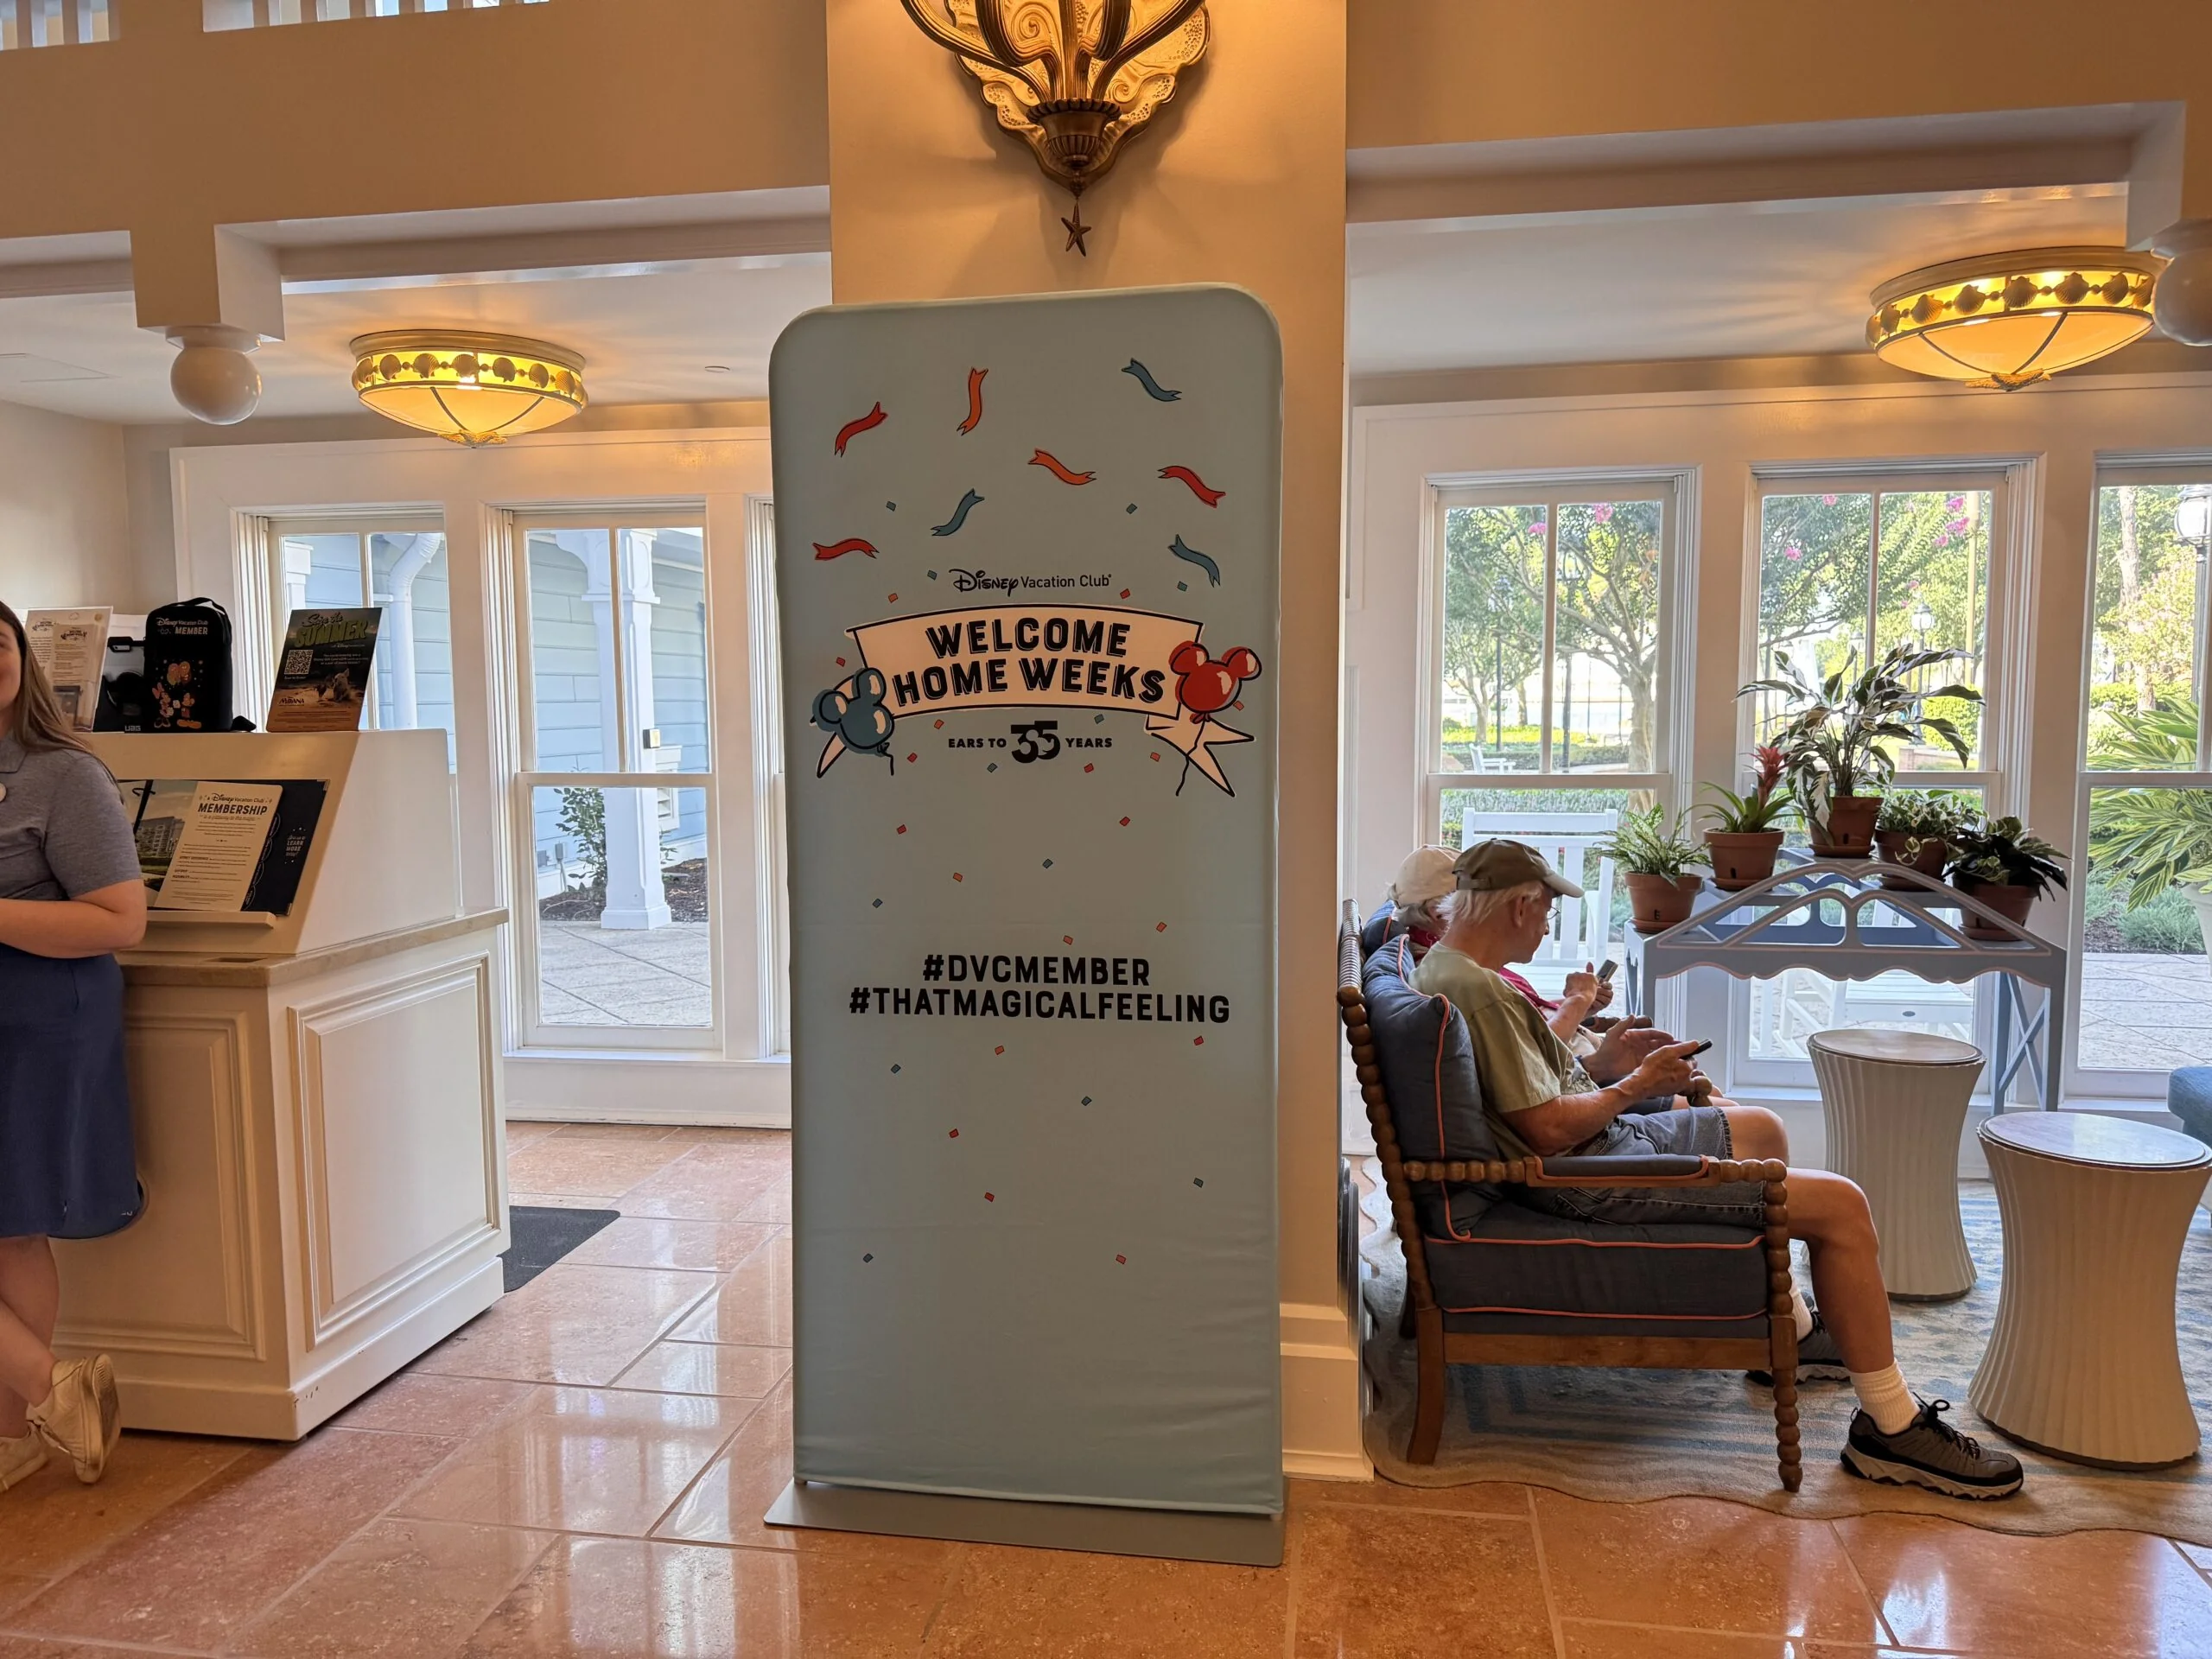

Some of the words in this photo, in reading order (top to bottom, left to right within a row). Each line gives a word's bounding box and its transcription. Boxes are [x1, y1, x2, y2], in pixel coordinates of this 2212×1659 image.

[949, 569, 1018, 597] Disney
[1020, 575, 1075, 588] Vacation
[156, 617, 177, 627] Disney
[175, 626, 208, 635] MEMBER
[295, 620, 368, 648] SUMMER
[924, 617, 1131, 660] WELCOME
[892, 658, 1009, 708] HOME
[1019, 657, 1166, 705] WEEKS
[949, 738, 984, 748] EARS
[988, 738, 1007, 748] TO
[1010, 720, 1060, 764] 35
[1065, 737, 1113, 748] YEARS
[197, 803, 268, 816] MEMBERSHIP
[211, 792, 234, 804] Disney
[922, 954, 1150, 987] #DVCMEMBER
[849, 987, 1230, 1024] #THATMAGICALFEELING
